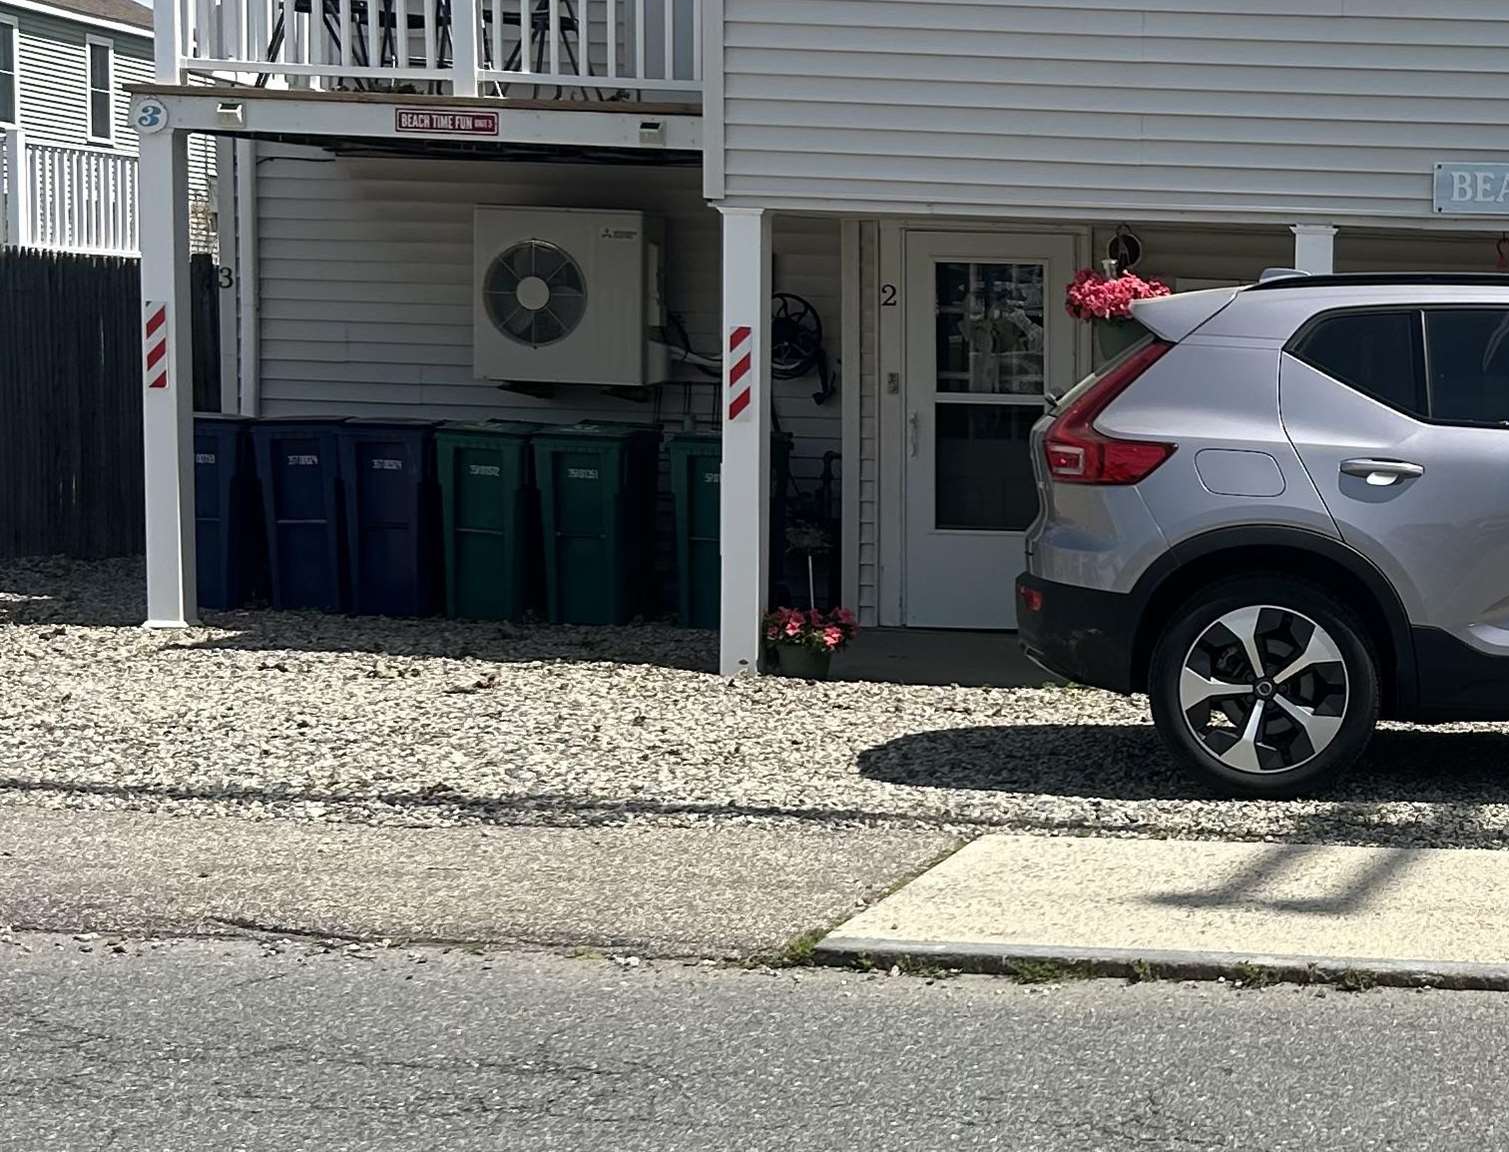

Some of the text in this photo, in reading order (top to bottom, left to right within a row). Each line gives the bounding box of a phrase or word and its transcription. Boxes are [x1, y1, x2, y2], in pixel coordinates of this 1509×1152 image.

[138, 105, 161, 127] 3
[401, 113, 430, 128] BEACH
[432, 114, 453, 129] TIME
[455, 115, 473, 129] FUN
[219, 266, 233, 289] 3
[881, 284, 897, 307] 2
